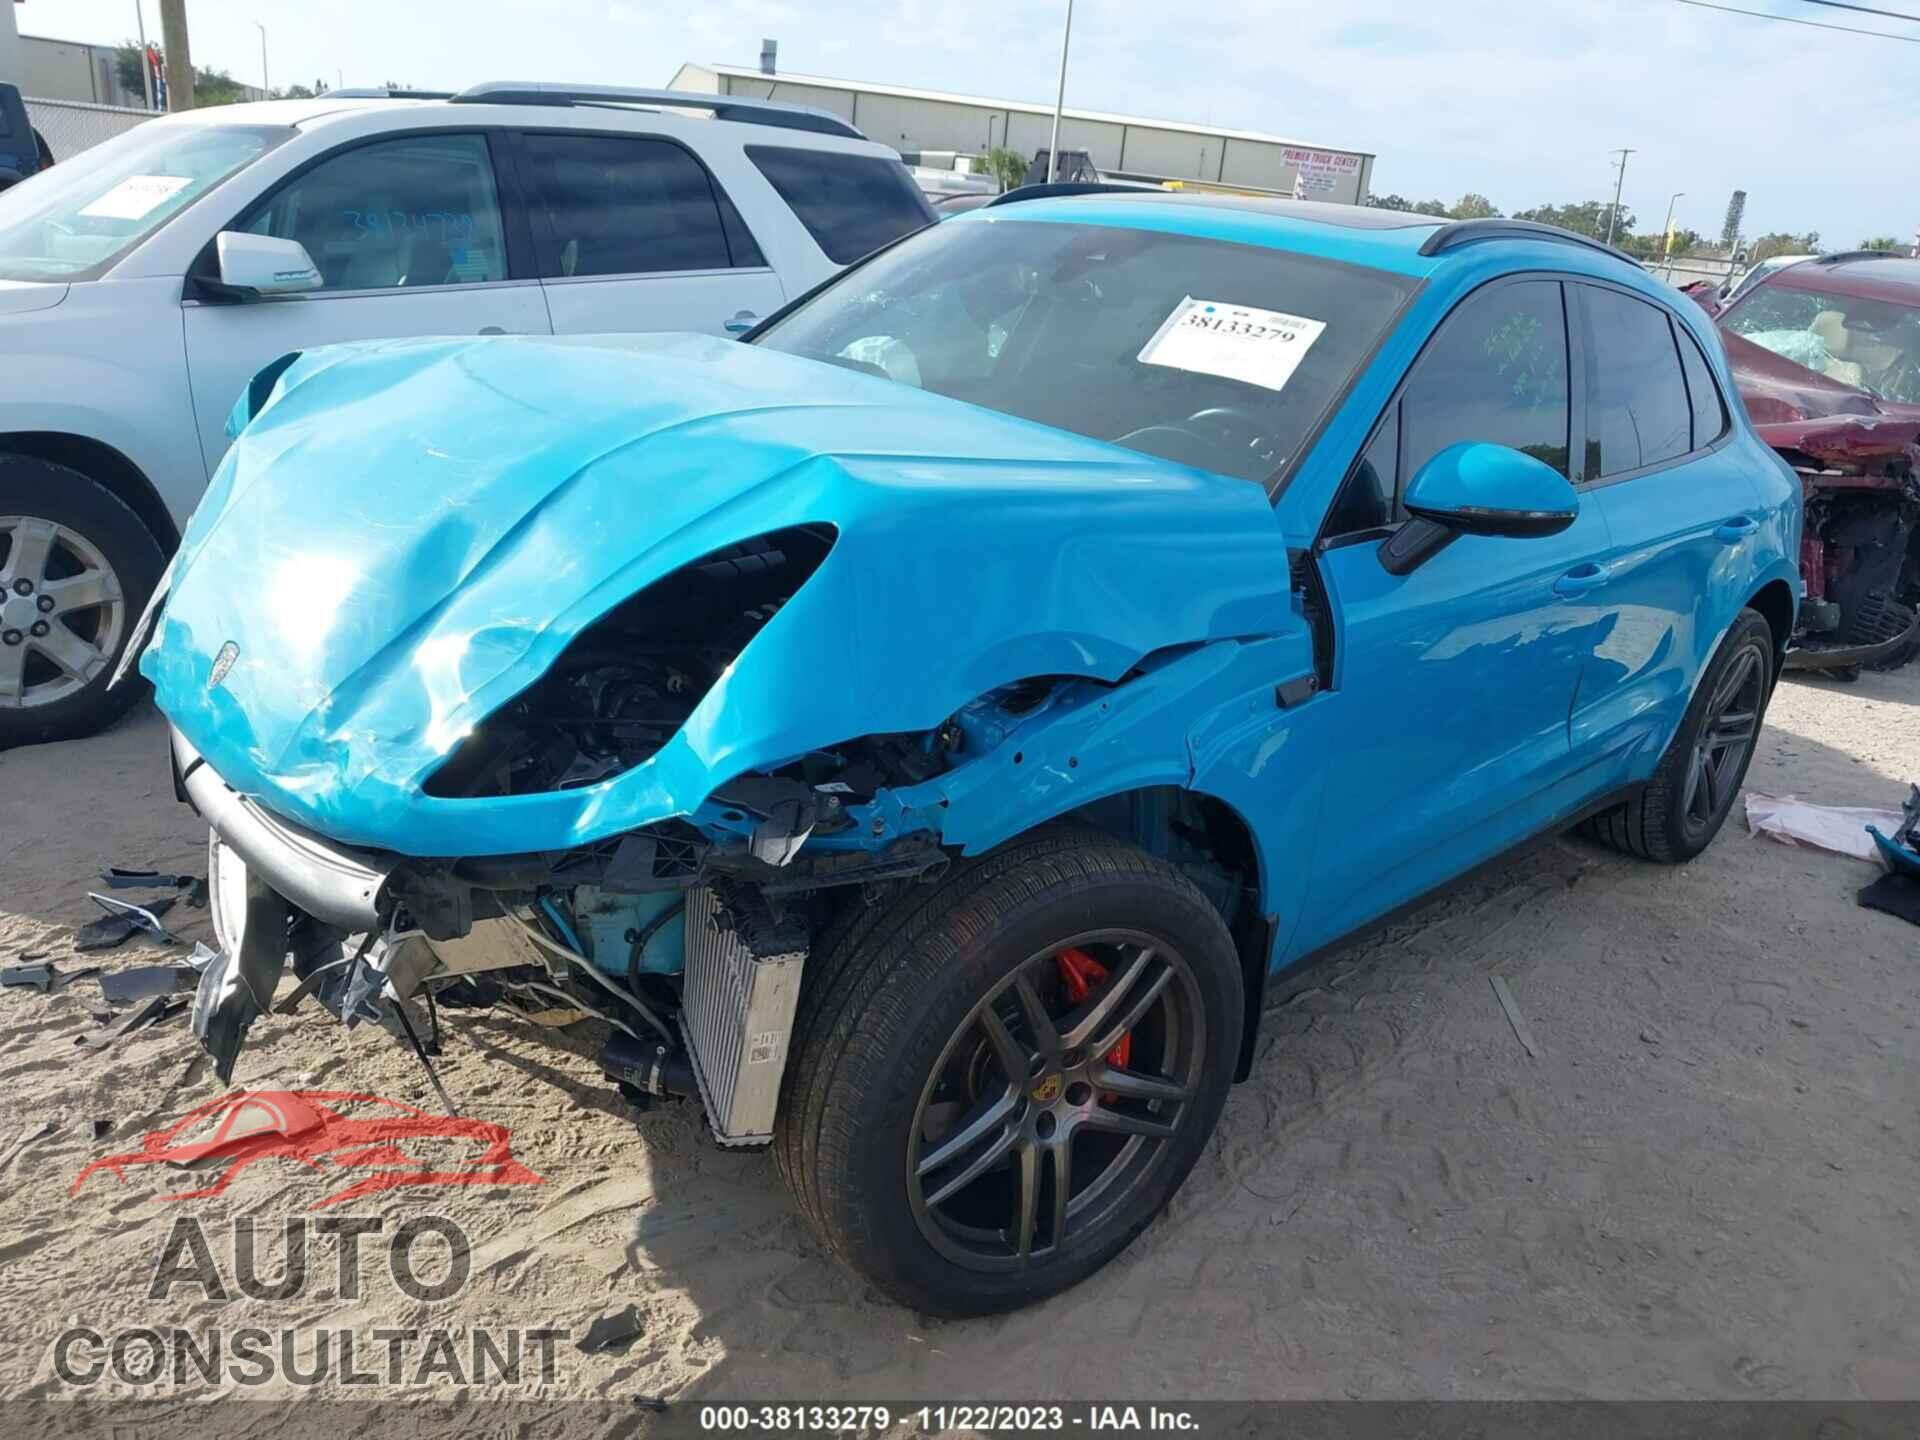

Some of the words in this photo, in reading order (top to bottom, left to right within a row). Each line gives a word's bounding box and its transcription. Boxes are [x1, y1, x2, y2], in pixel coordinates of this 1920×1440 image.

[1283, 149, 1311, 161] PREMIER
[1312, 153, 1333, 164] TRUCK
[1334, 156, 1359, 168] CENTER
[1181, 314, 1296, 342] 38133279
